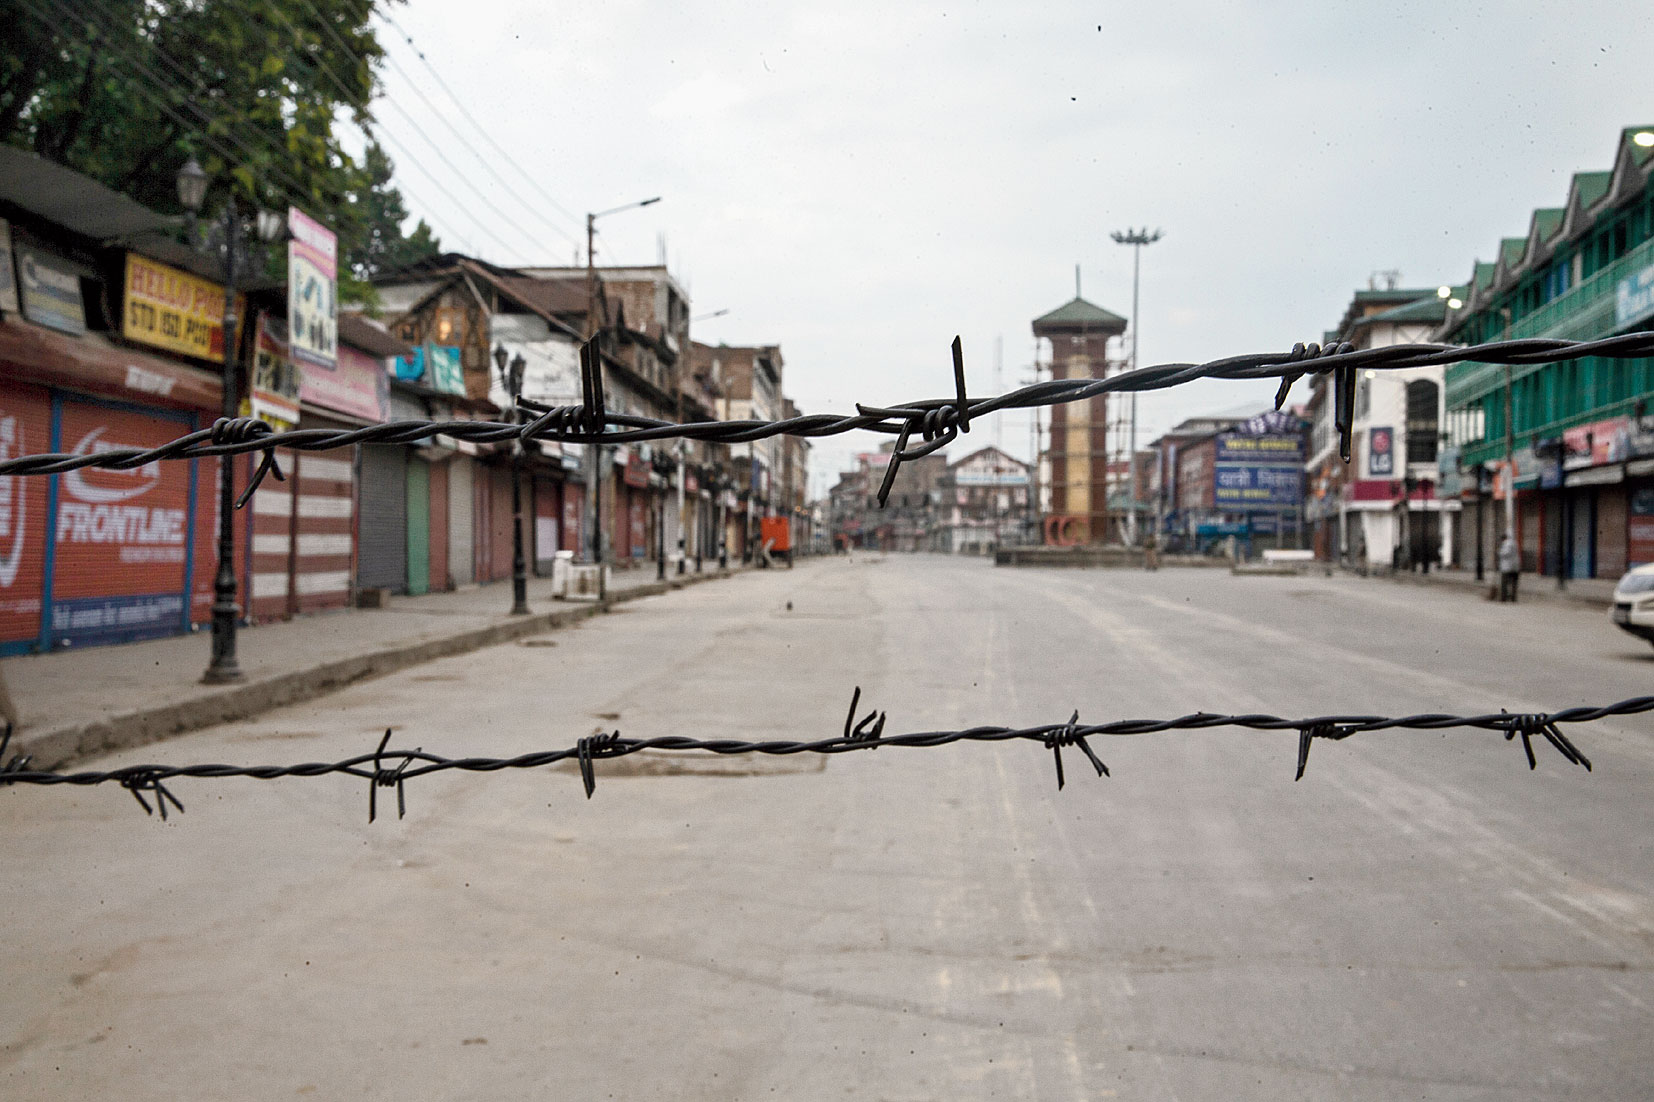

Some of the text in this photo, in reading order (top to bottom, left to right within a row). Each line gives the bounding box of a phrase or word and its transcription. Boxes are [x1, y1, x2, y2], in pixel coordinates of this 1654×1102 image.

[132, 263, 192, 311] HELLO
[130, 302, 209, 347] STD ISD PCO
[1371, 454, 1391, 472] LG
[57, 502, 185, 543] FRONTLINE
